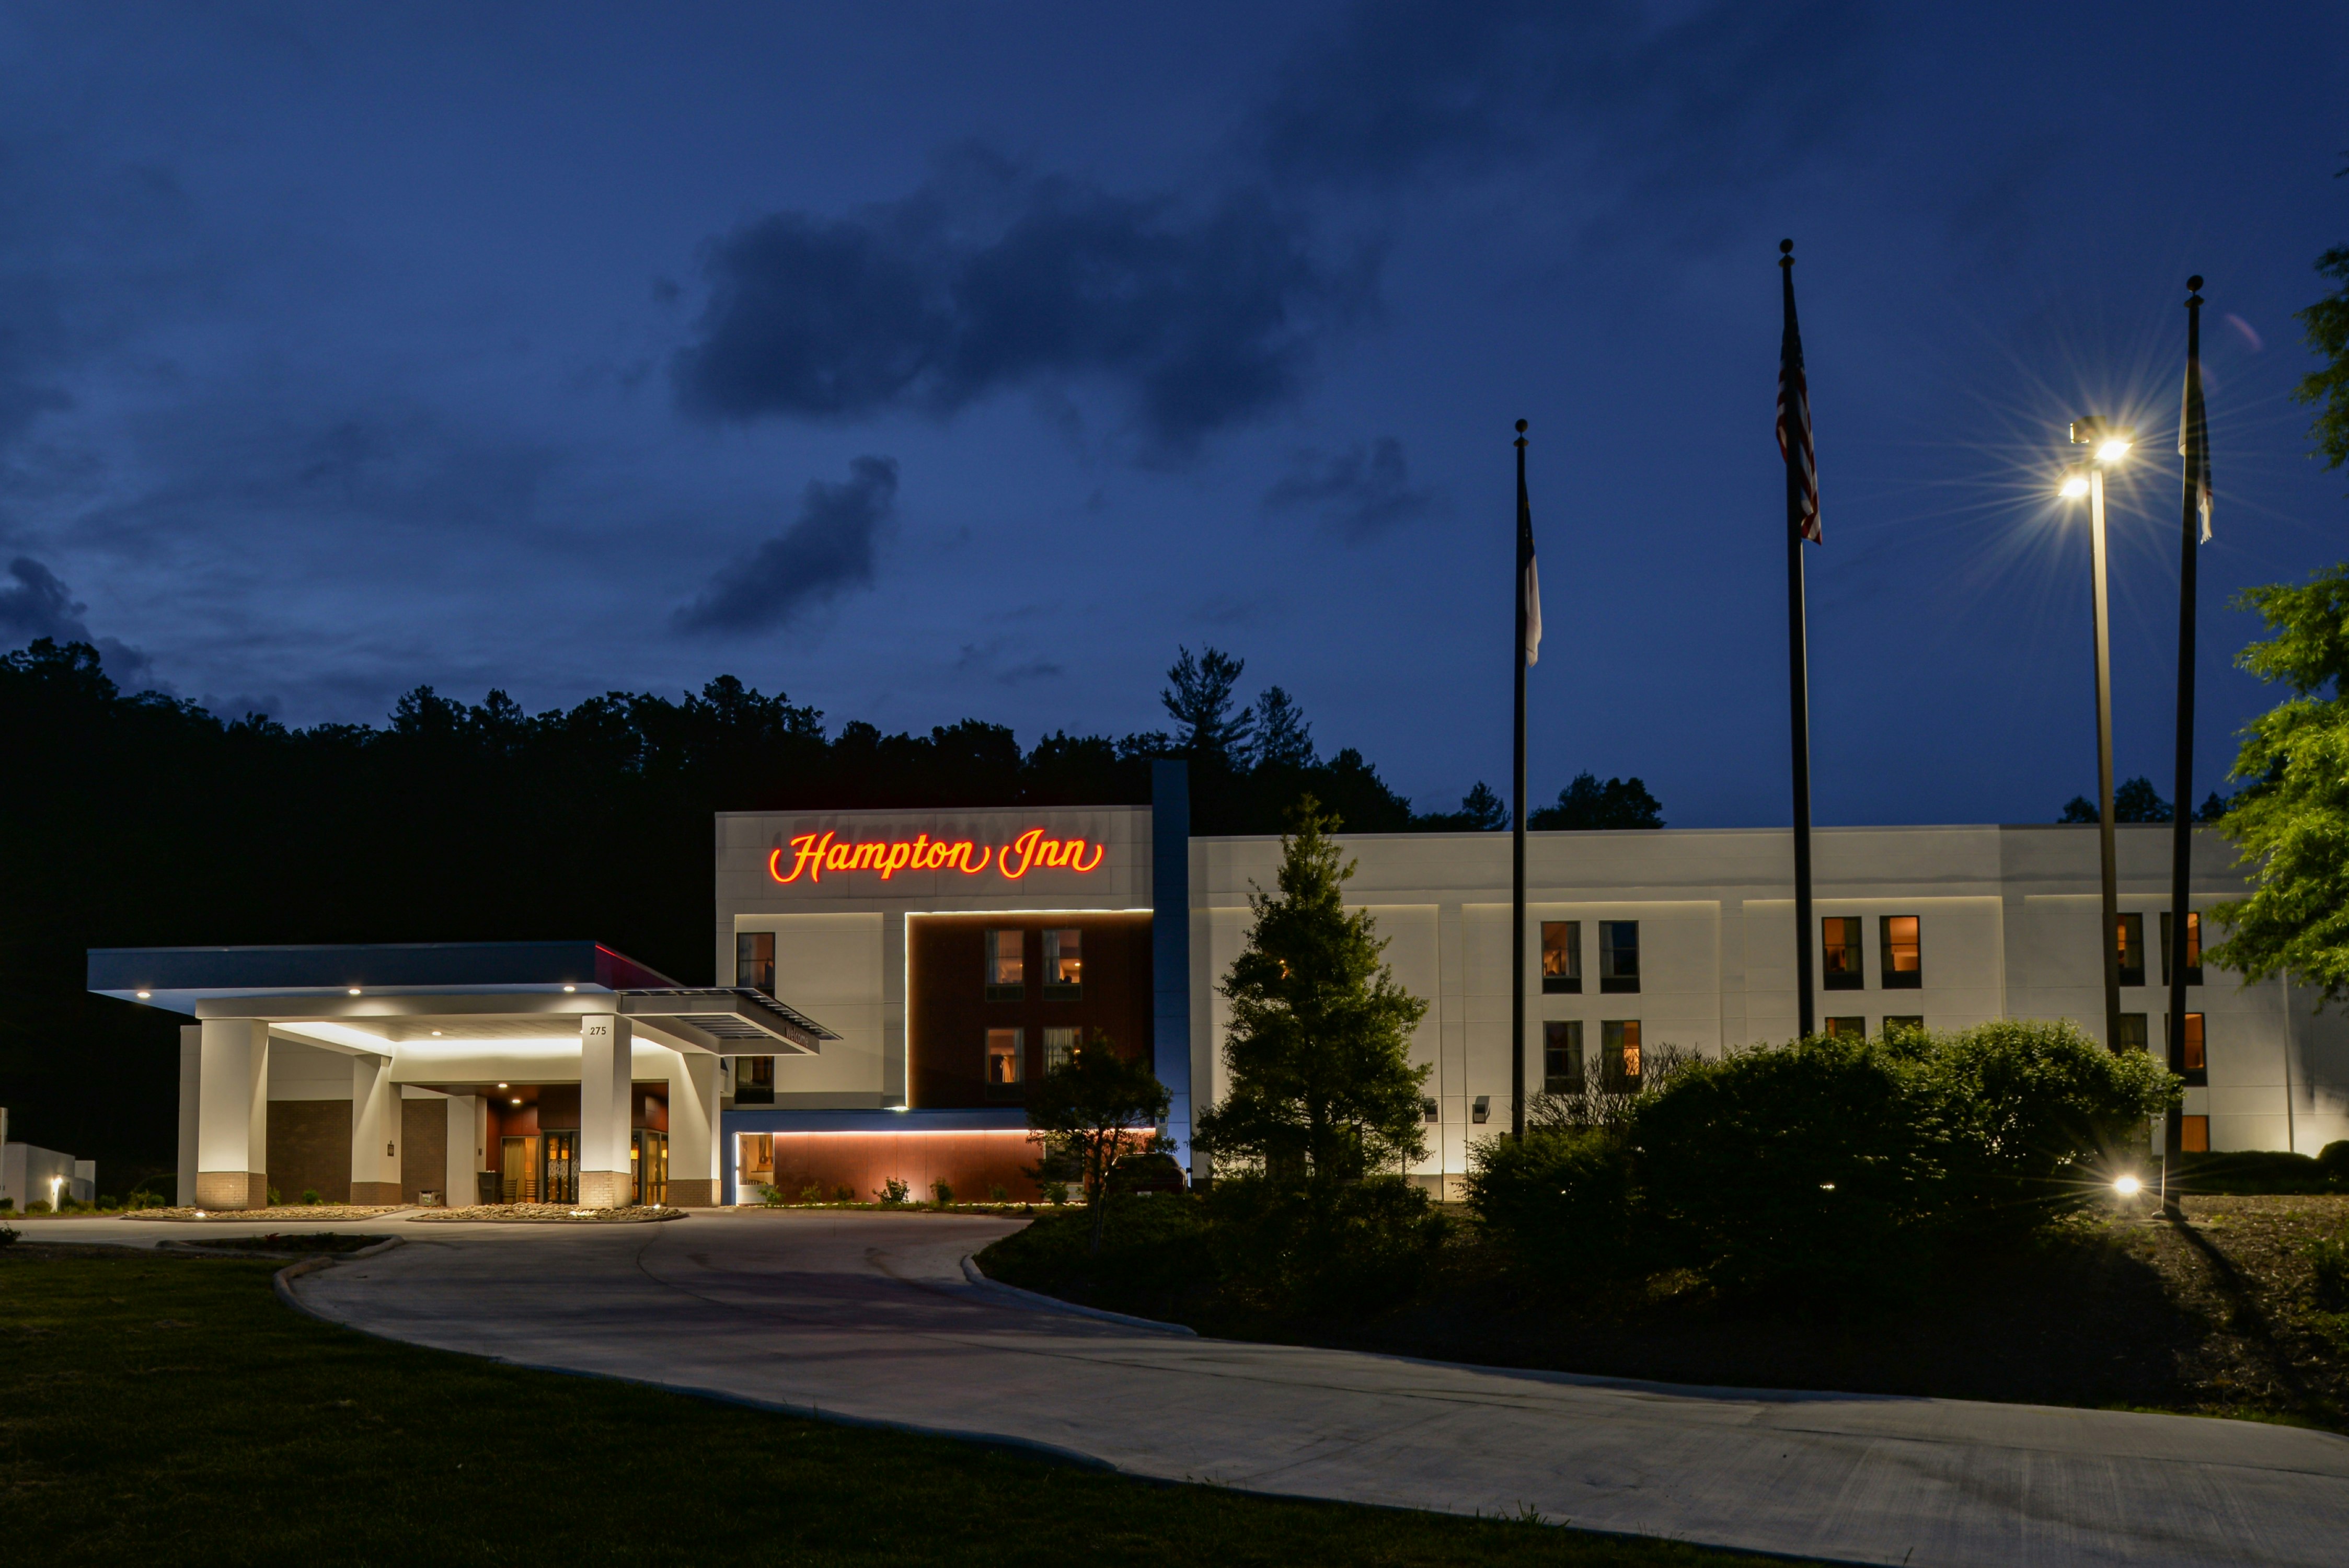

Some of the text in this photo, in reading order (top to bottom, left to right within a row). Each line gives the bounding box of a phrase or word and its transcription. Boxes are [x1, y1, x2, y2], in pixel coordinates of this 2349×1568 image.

[769, 827, 1104, 883] Hampton Inn
[590, 1027, 606, 1035] 275
[786, 1026, 809, 1047] welcome
